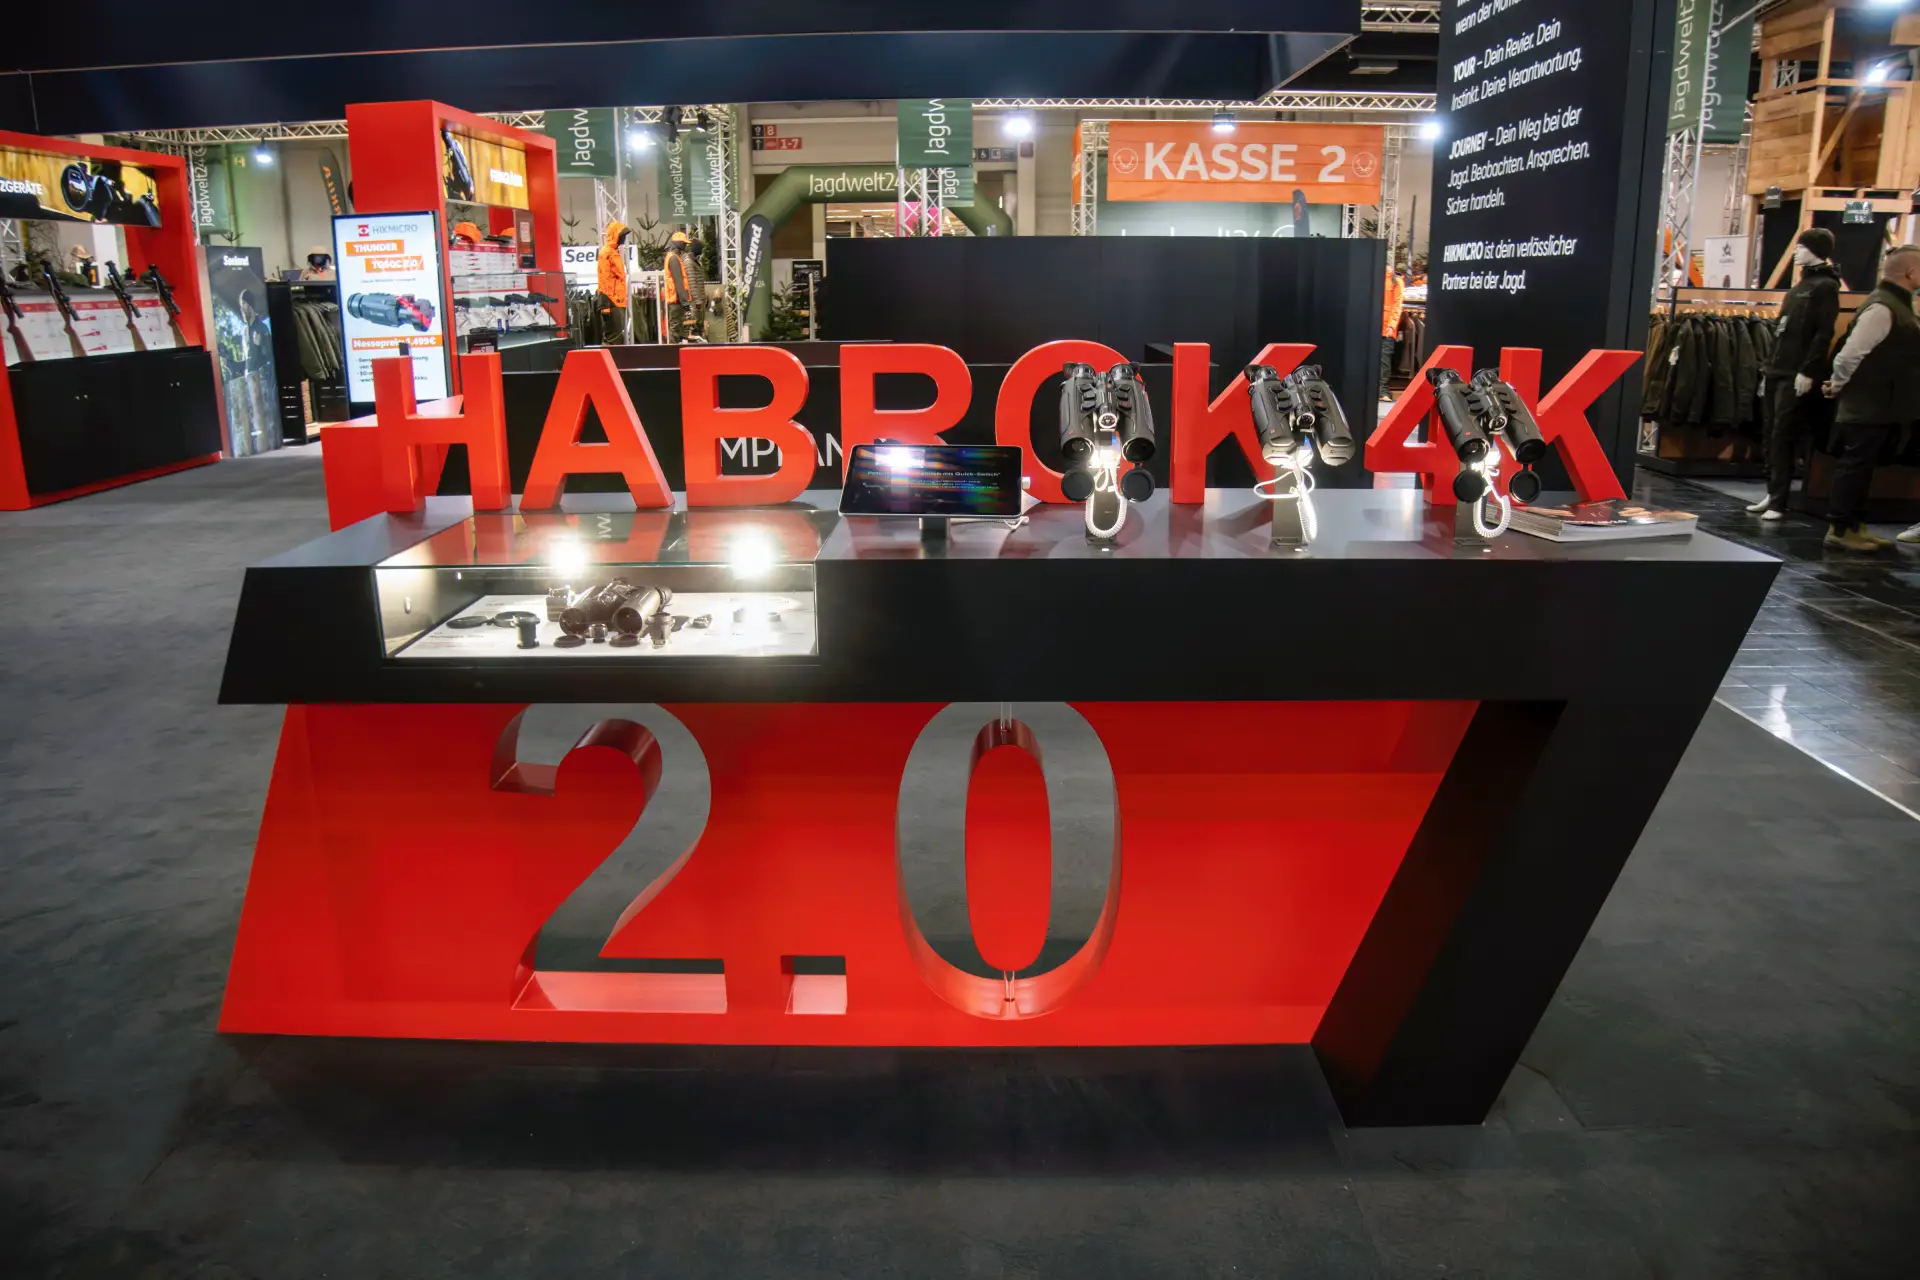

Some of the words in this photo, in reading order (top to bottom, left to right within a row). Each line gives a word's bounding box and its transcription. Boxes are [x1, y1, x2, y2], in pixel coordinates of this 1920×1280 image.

[1455, 12, 1477, 36] wenn
[1477, 2, 1492, 23] der
[1453, 56, 1476, 83] YOUR
[1484, 45, 1504, 69] Dein
[1504, 32, 1534, 60] Revier.
[1536, 18, 1561, 45] Dein
[1451, 85, 1480, 112] Instinkt.
[1480, 76, 1507, 100] Deine
[1508, 47, 1583, 90] Verantwortung.
[766, 126, 775, 137] 8
[780, 139, 799, 149] 1-7
[1449, 131, 1488, 160] JOURNEY
[1495, 124, 1517, 146] Dein
[1518, 117, 1541, 141] Weg
[1542, 108, 1560, 134] bei
[1561, 105, 1583, 128] der
[1144, 142, 1298, 182] KASSE
[1317, 145, 1346, 183] 2
[1447, 165, 1469, 190] Jagd.
[1470, 155, 1525, 183] Beobachten.
[1526, 140, 1590, 172] Ansprechen.
[194, 156, 216, 227] Jagdwelt24
[670, 155, 688, 217] Jagdwelt24
[1446, 197, 1469, 215] Sicher
[1470, 187, 1506, 212] handeln.
[353, 242, 398, 253] THUNDER
[372, 224, 418, 234] HIKMICRO
[1443, 241, 1484, 263] HIKMICRO
[1484, 240, 1495, 260] ist
[1495, 239, 1515, 259] dein
[1516, 234, 1578, 258] verlässlicher
[742, 223, 763, 298] Seeland
[1442, 272, 1469, 290] Partner
[1470, 271, 1484, 289] bei
[1484, 271, 1500, 289] der
[1500, 269, 1526, 294] Jagd.
[373, 340, 1317, 514] HABROK
[1365, 343, 1644, 512] 4K
[490, 702, 1122, 1022] 2.0
